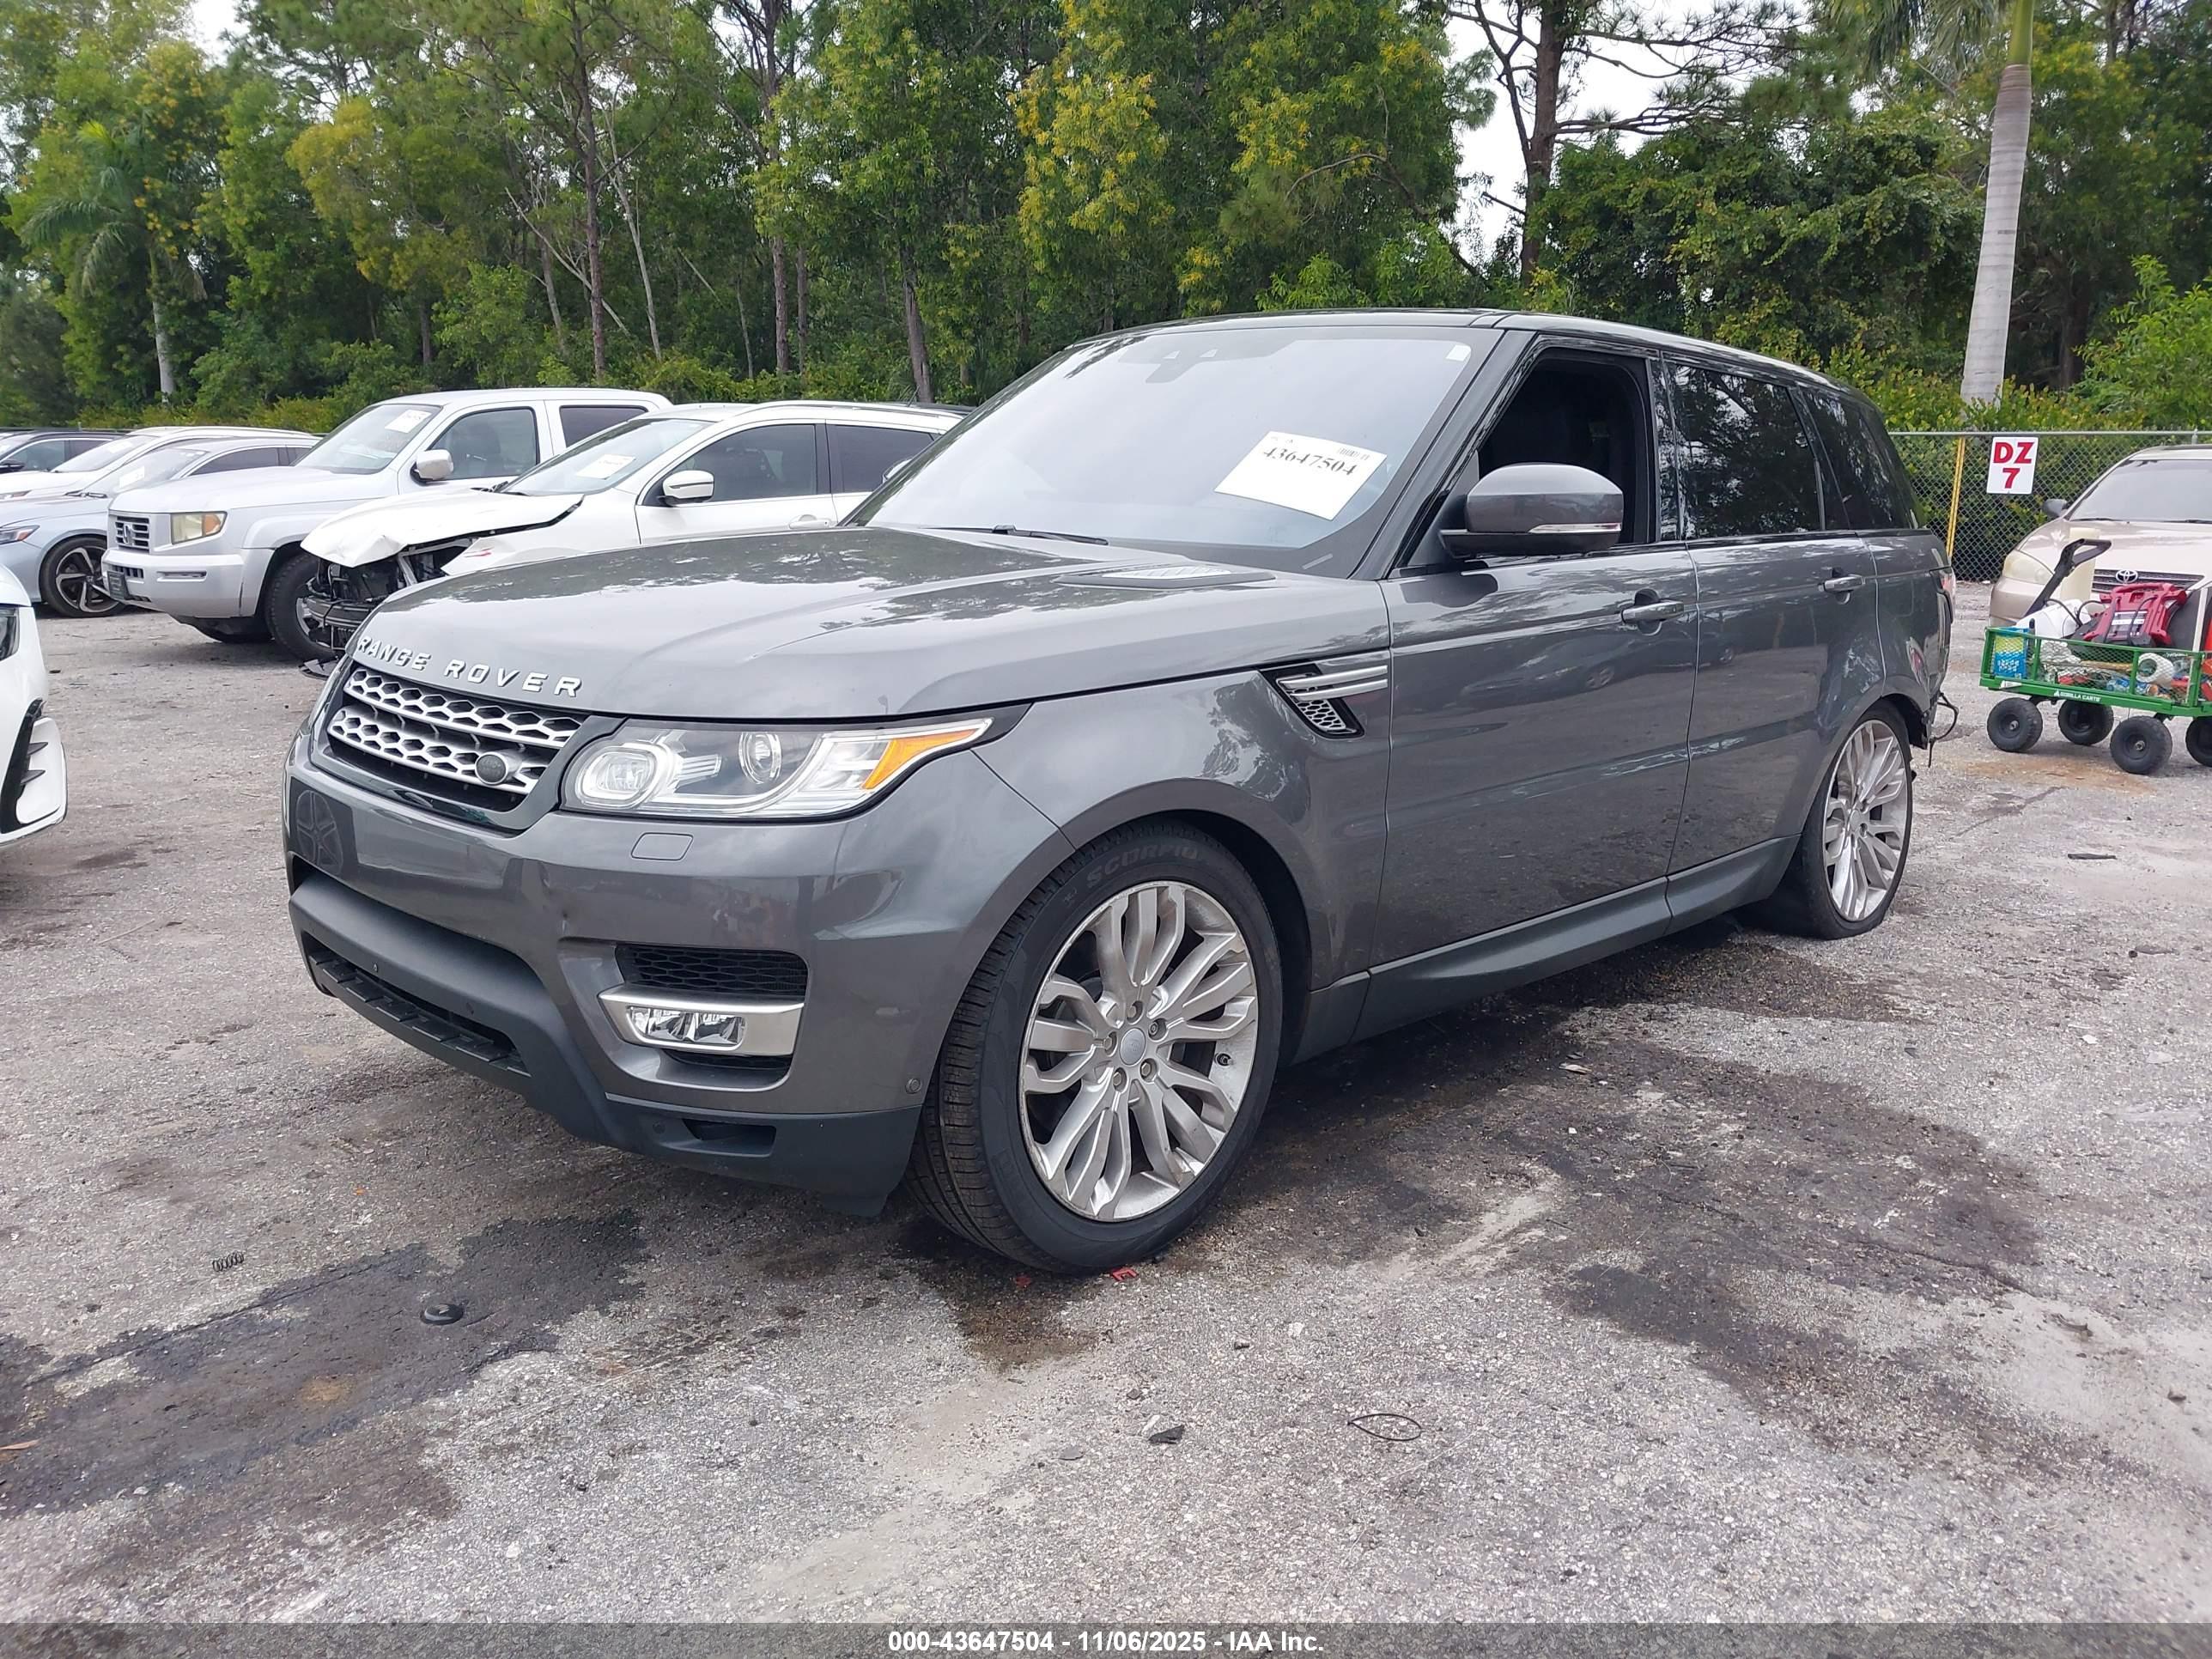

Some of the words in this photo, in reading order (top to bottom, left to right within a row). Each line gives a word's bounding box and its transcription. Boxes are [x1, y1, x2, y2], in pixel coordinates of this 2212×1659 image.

[1263, 447, 1358, 476] 43647504
[1993, 441, 2034, 464] DZ
[2002, 467, 2021, 489] 7
[357, 636, 432, 672] RANGE
[444, 659, 583, 697] ROVER
